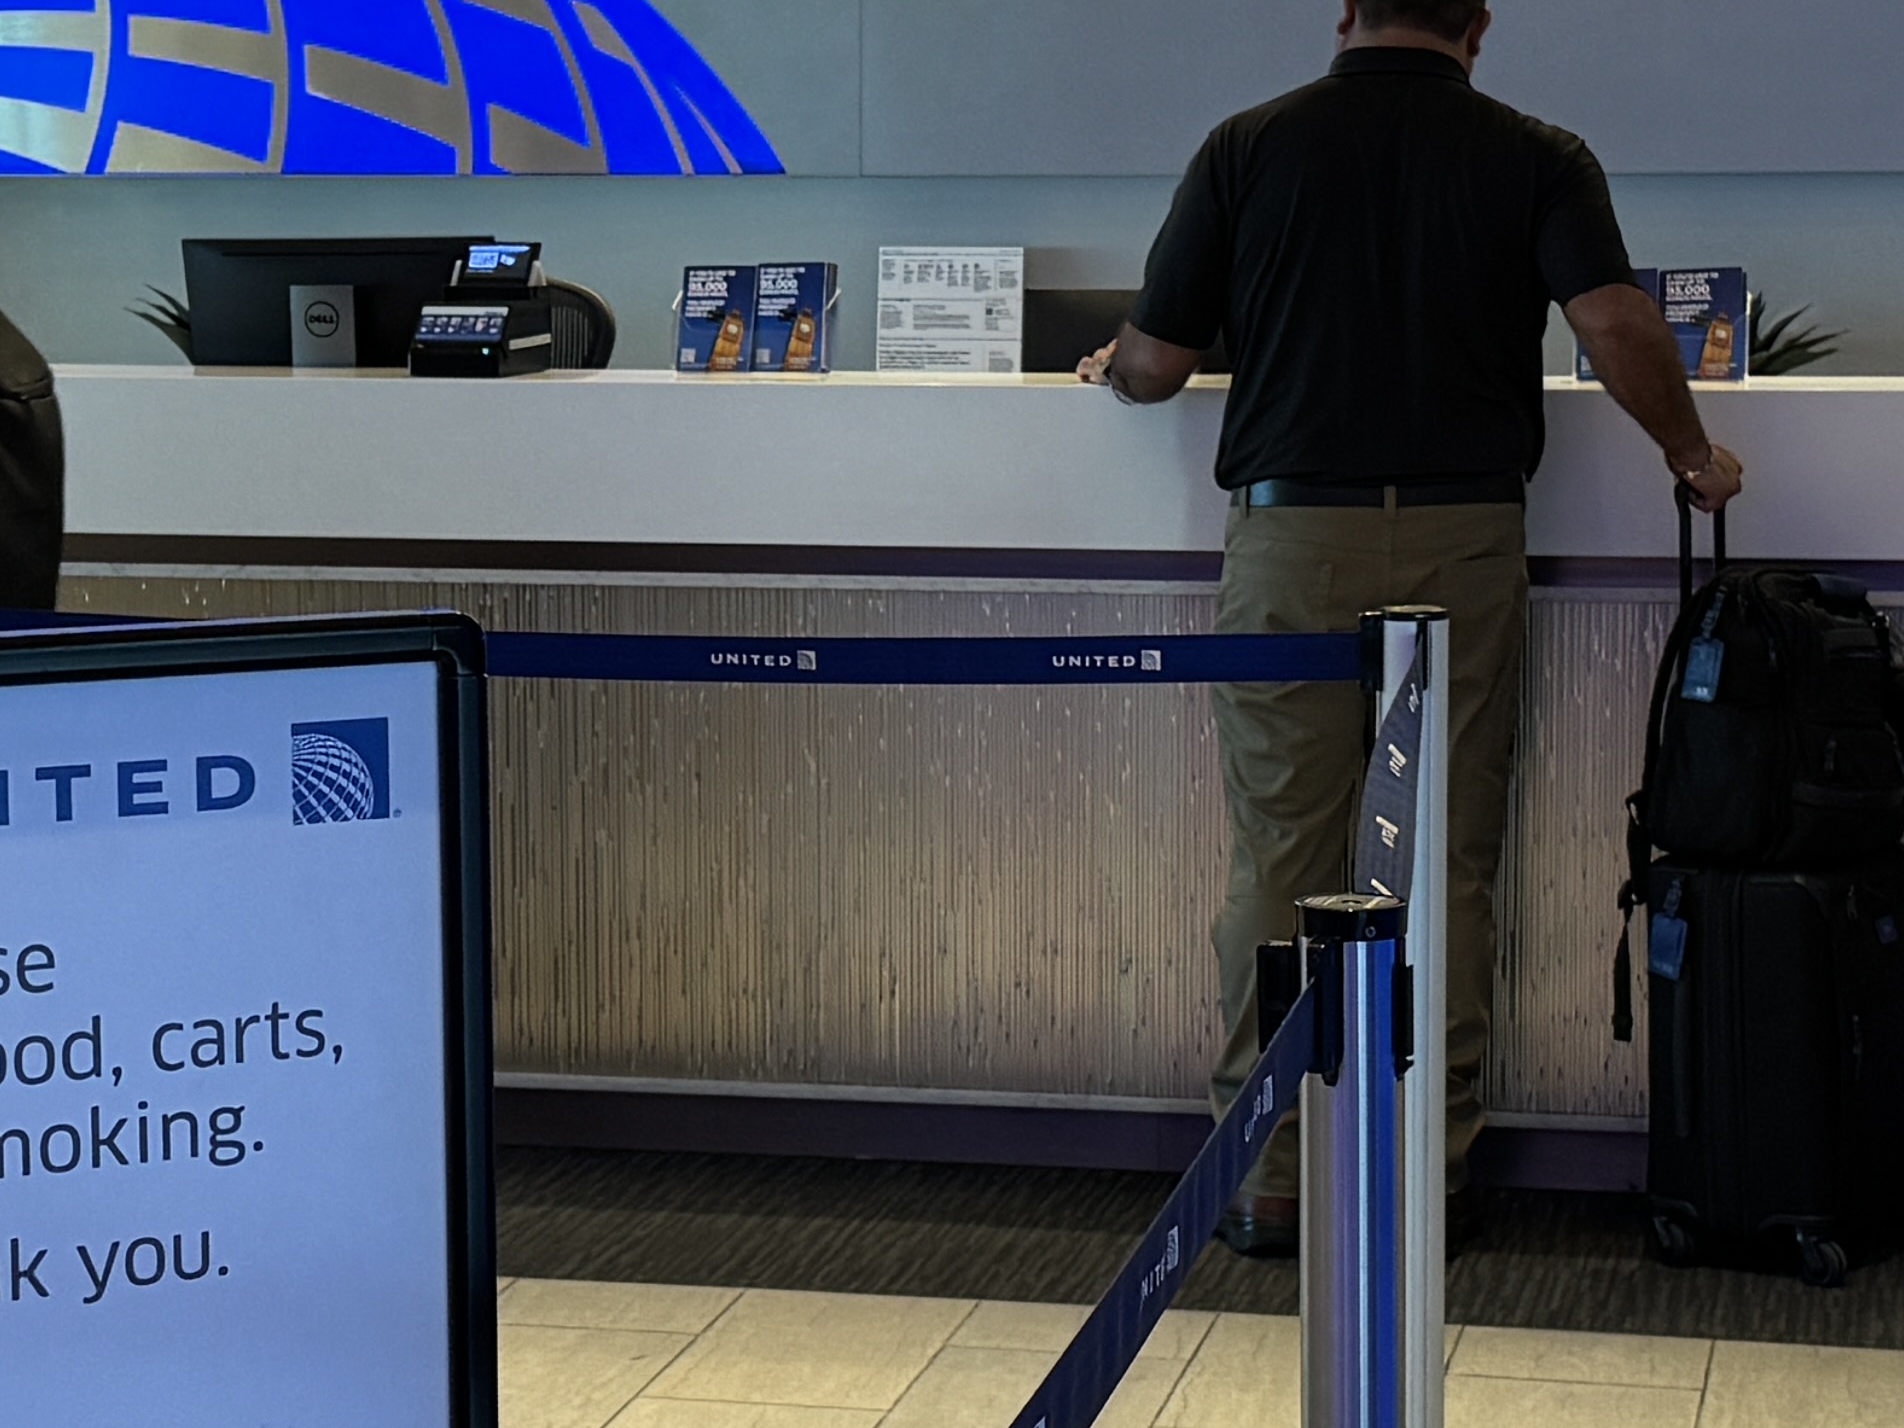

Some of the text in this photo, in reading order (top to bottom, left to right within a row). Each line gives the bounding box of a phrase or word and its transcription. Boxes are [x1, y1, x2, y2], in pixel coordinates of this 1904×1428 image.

[710, 653, 792, 667] UNITED
[1052, 655, 1136, 668] UNITED
[152, 1001, 344, 1072] carts,
[76, 1228, 230, 1304] you.
